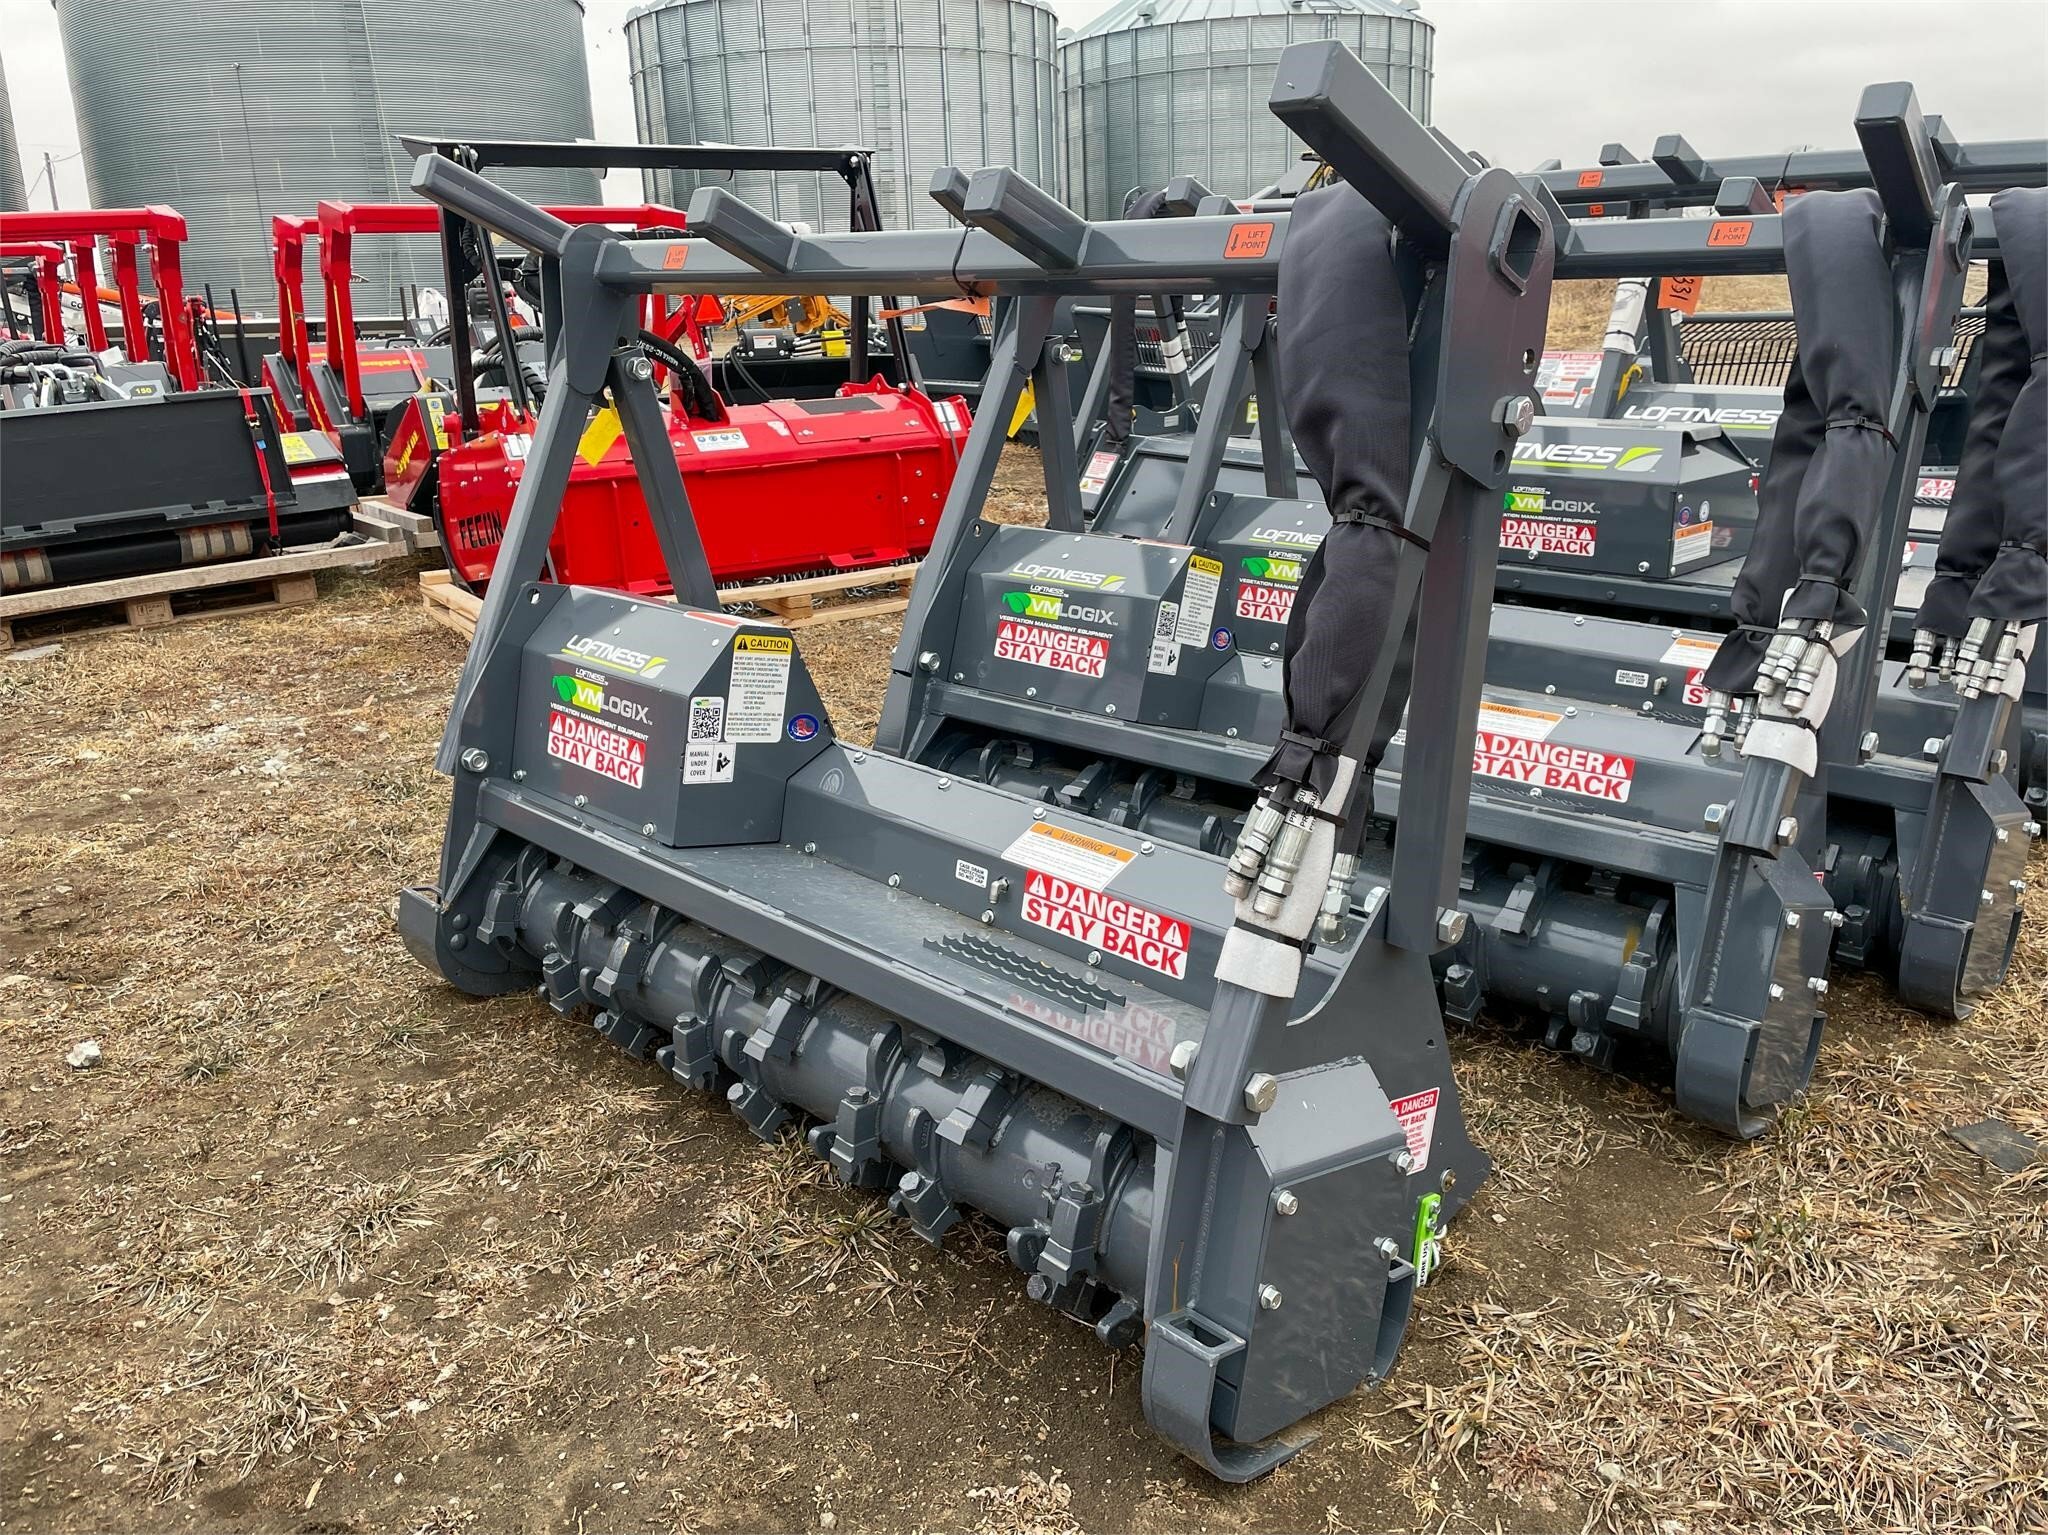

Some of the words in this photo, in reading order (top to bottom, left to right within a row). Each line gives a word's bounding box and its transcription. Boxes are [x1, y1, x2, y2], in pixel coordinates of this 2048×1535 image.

[1248, 230, 1266, 238] LIFT
[1623, 405, 1784, 424] LOFTNESS
[1512, 442, 1624, 463] TNESS
[1515, 497, 1596, 514] VMLOGIX
[459, 510, 504, 550] FECON
[1505, 520, 1578, 540] DANGER
[1521, 514, 1562, 522] MANAGEMENT
[1562, 517, 1598, 525] EQUIPMENT
[1252, 527, 1325, 545] LOFTNE
[1502, 534, 1537, 549] TAY
[1541, 538, 1591, 555] BACK
[1268, 550, 1303, 559] LOFTNESS
[1013, 562, 1106, 584] LOFTNESS
[1198, 560, 1221, 571] CAUTION
[1030, 585, 1065, 594] LOFTNESS
[1239, 577, 1273, 587] VEGETATION
[1256, 588, 1296, 608] DAN
[1031, 598, 1114, 625] VMLOGIX
[1240, 602, 1287, 622] STAY
[1000, 614, 1034, 625] VEGETATION
[1034, 620, 1077, 633] MANAGEMENT
[1077, 627, 1114, 639] EQUIPMENT
[750, 638, 789, 649] CAUTION
[1015, 625, 1090, 655] DANGER
[566, 634, 651, 669] LOFTNESS
[998, 641, 1046, 664] STAY
[1049, 651, 1101, 676] BACK
[575, 667, 606, 681] LOFTNESS
[577, 684, 649, 724] VMLOGIX
[550, 702, 580, 717] VEGETATION
[580, 713, 617, 731] MANAGEMENT
[617, 725, 649, 741] EQUIPMENT
[565, 717, 630, 759] DANGER
[551, 735, 591, 766] STAY
[595, 751, 640, 786] BACK
[1490, 735, 1606, 775] DANGER
[1545, 766, 1625, 800] BACK
[1059, 832, 1103, 852] WARNING
[1051, 880, 1162, 944] DANGER
[1026, 898, 1097, 942] STAY
[1103, 927, 1183, 977] BACK
[1401, 1093, 1435, 1114] DANGER
[1410, 1111, 1428, 1125] BACK
